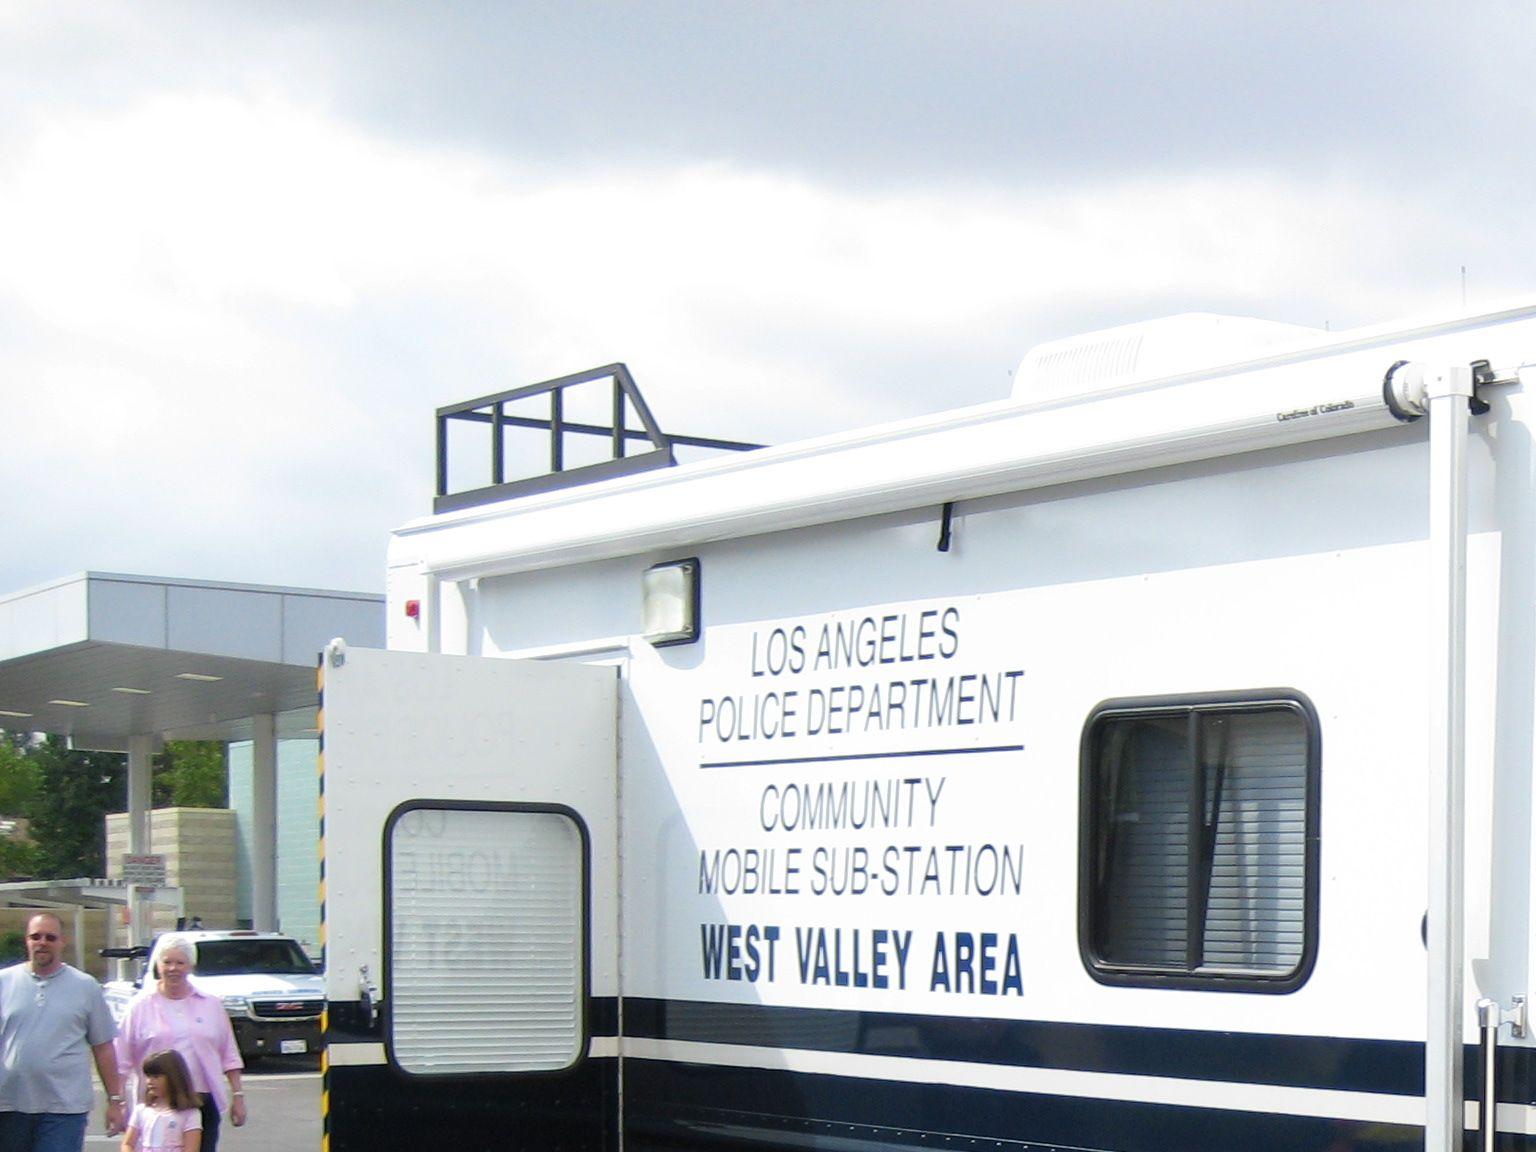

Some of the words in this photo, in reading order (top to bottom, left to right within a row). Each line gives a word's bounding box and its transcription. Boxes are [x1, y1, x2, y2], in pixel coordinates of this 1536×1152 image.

[752, 625, 806, 677] LOS
[814, 607, 960, 671] ANGELES
[699, 691, 798, 743] POLICE
[807, 670, 1024, 736] DEPARTMENT
[760, 777, 946, 832] COMMUNITY
[699, 848, 802, 895] MOBILE
[811, 844, 1025, 896] SUB-STATION
[701, 924, 780, 983] WEST
[795, 927, 913, 990] VALLEY
[930, 931, 1024, 997] AREA
